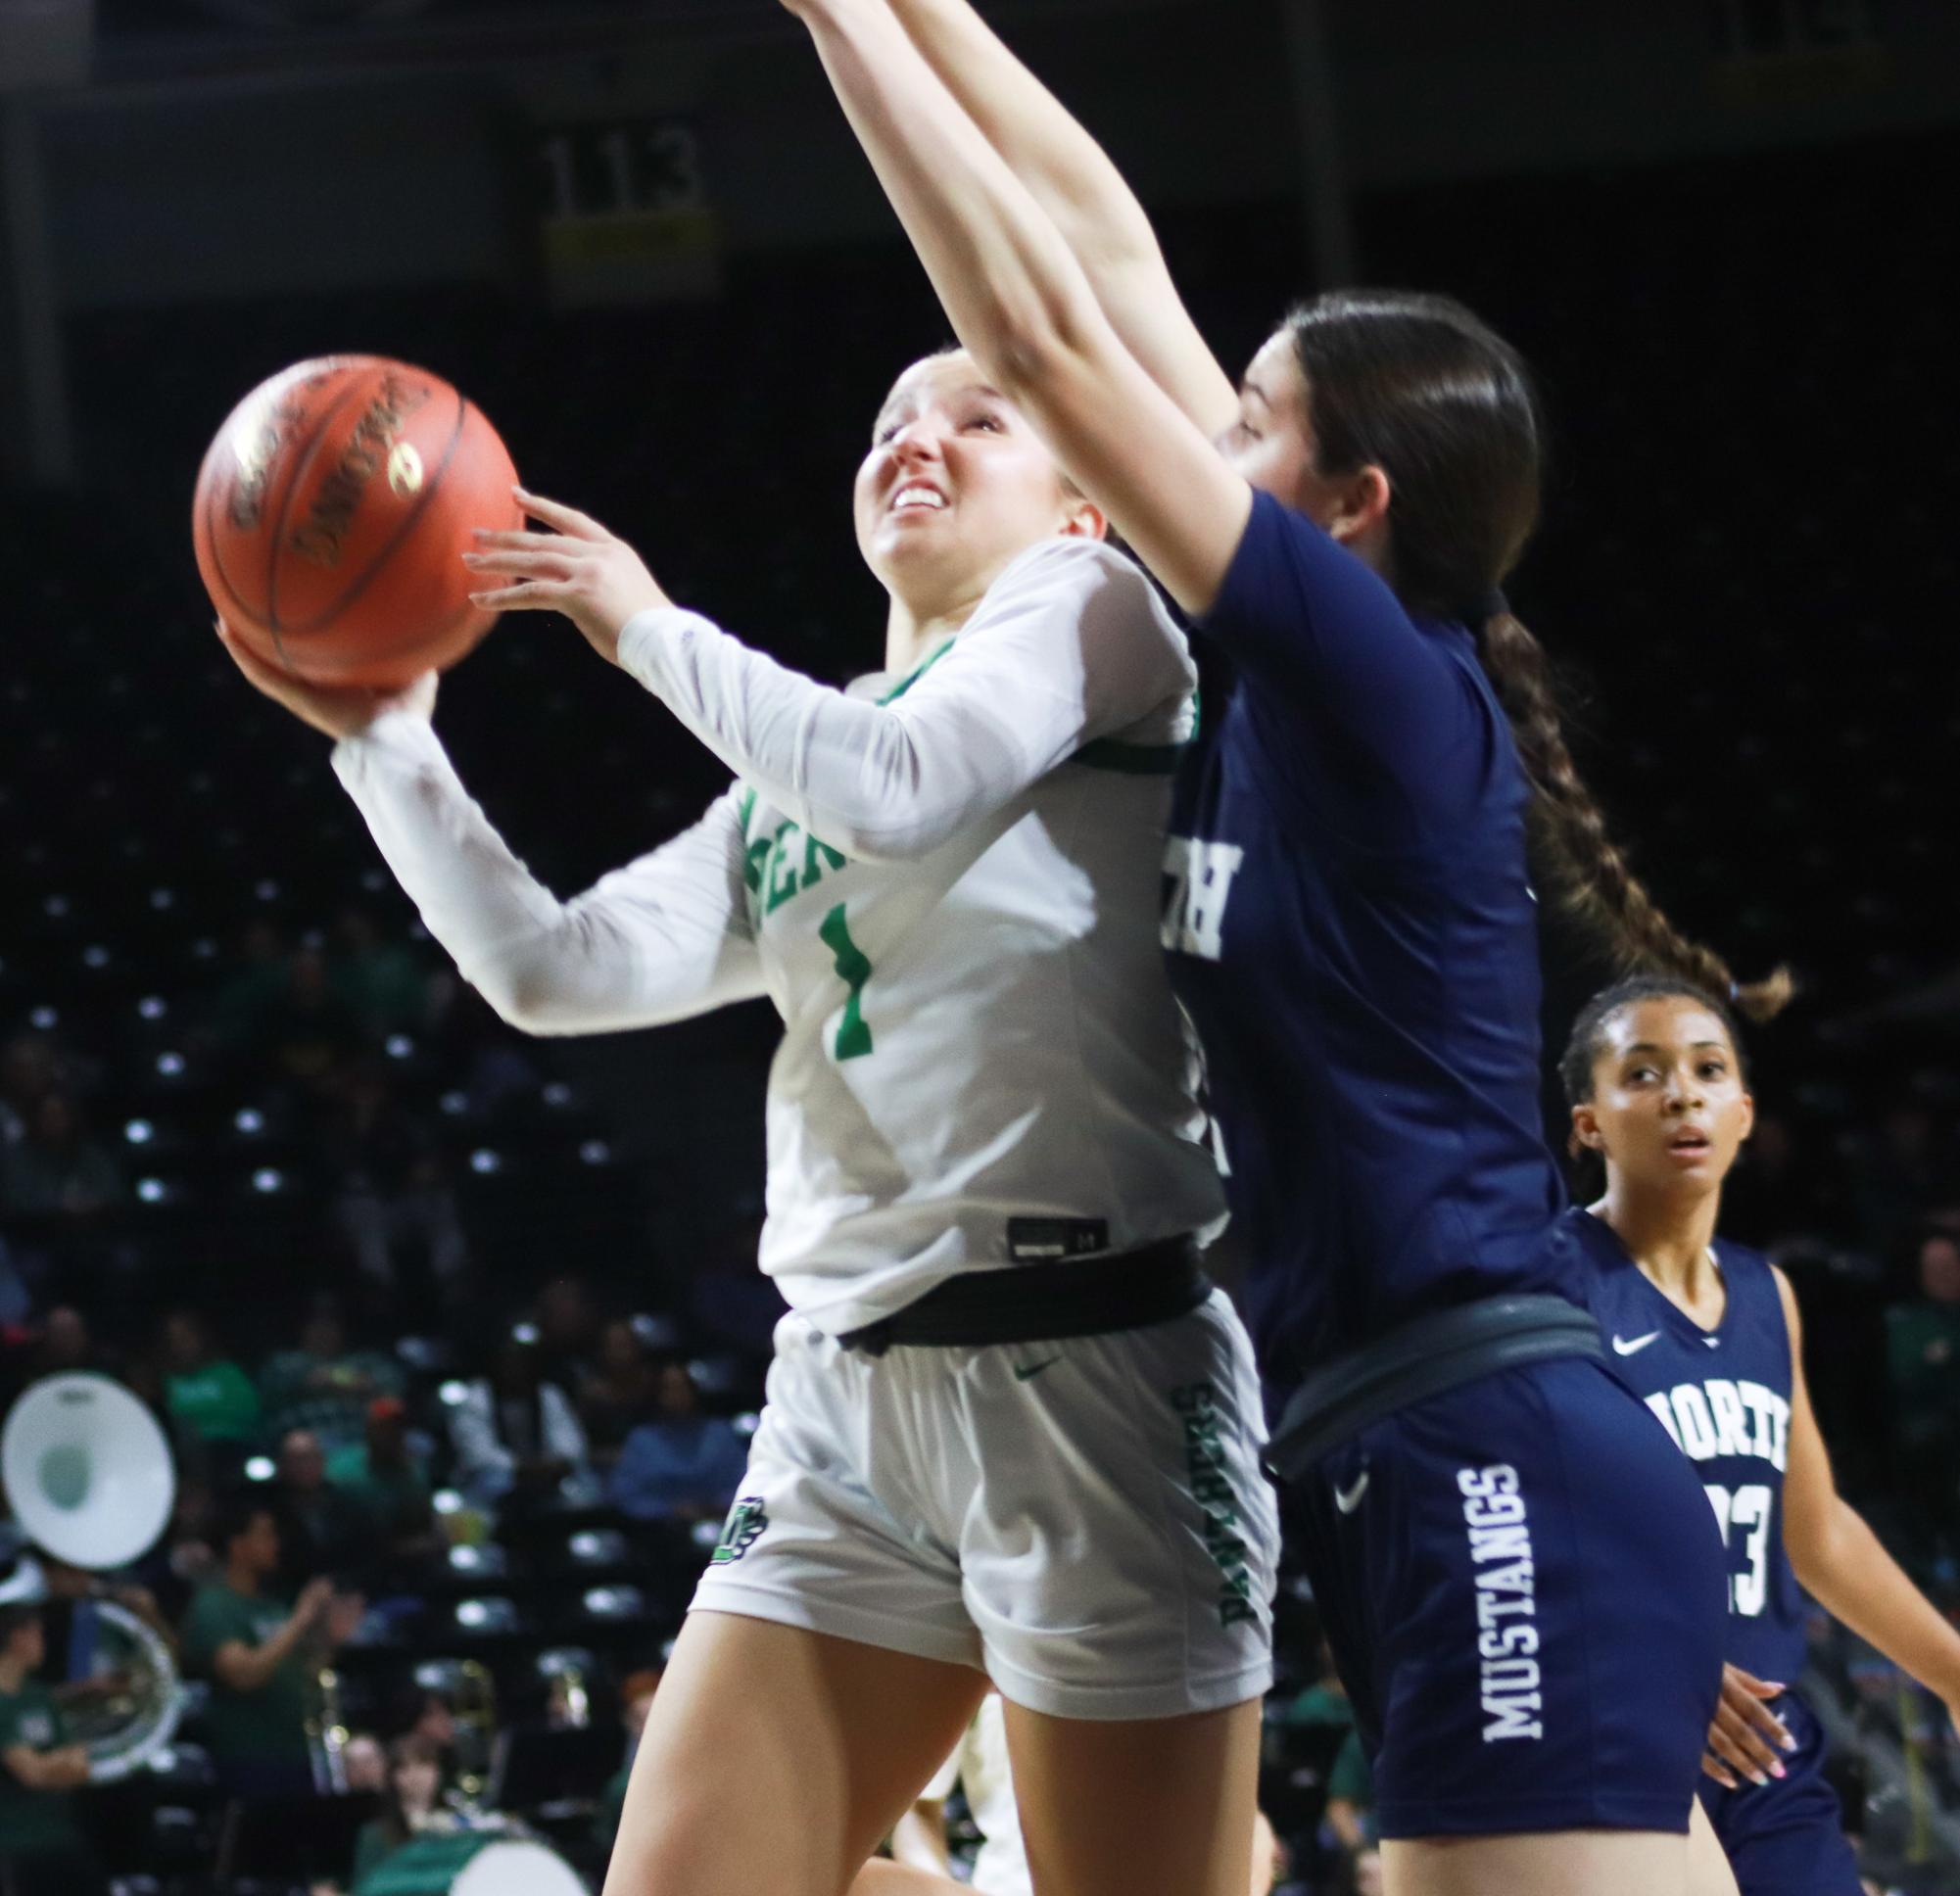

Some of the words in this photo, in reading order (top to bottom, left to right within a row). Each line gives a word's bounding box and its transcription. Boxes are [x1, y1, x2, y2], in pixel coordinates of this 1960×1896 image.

[541, 125, 705, 217] 113
[818, 902, 873, 1062] 1
[1457, 1464, 1543, 1743] MUSTANGS
